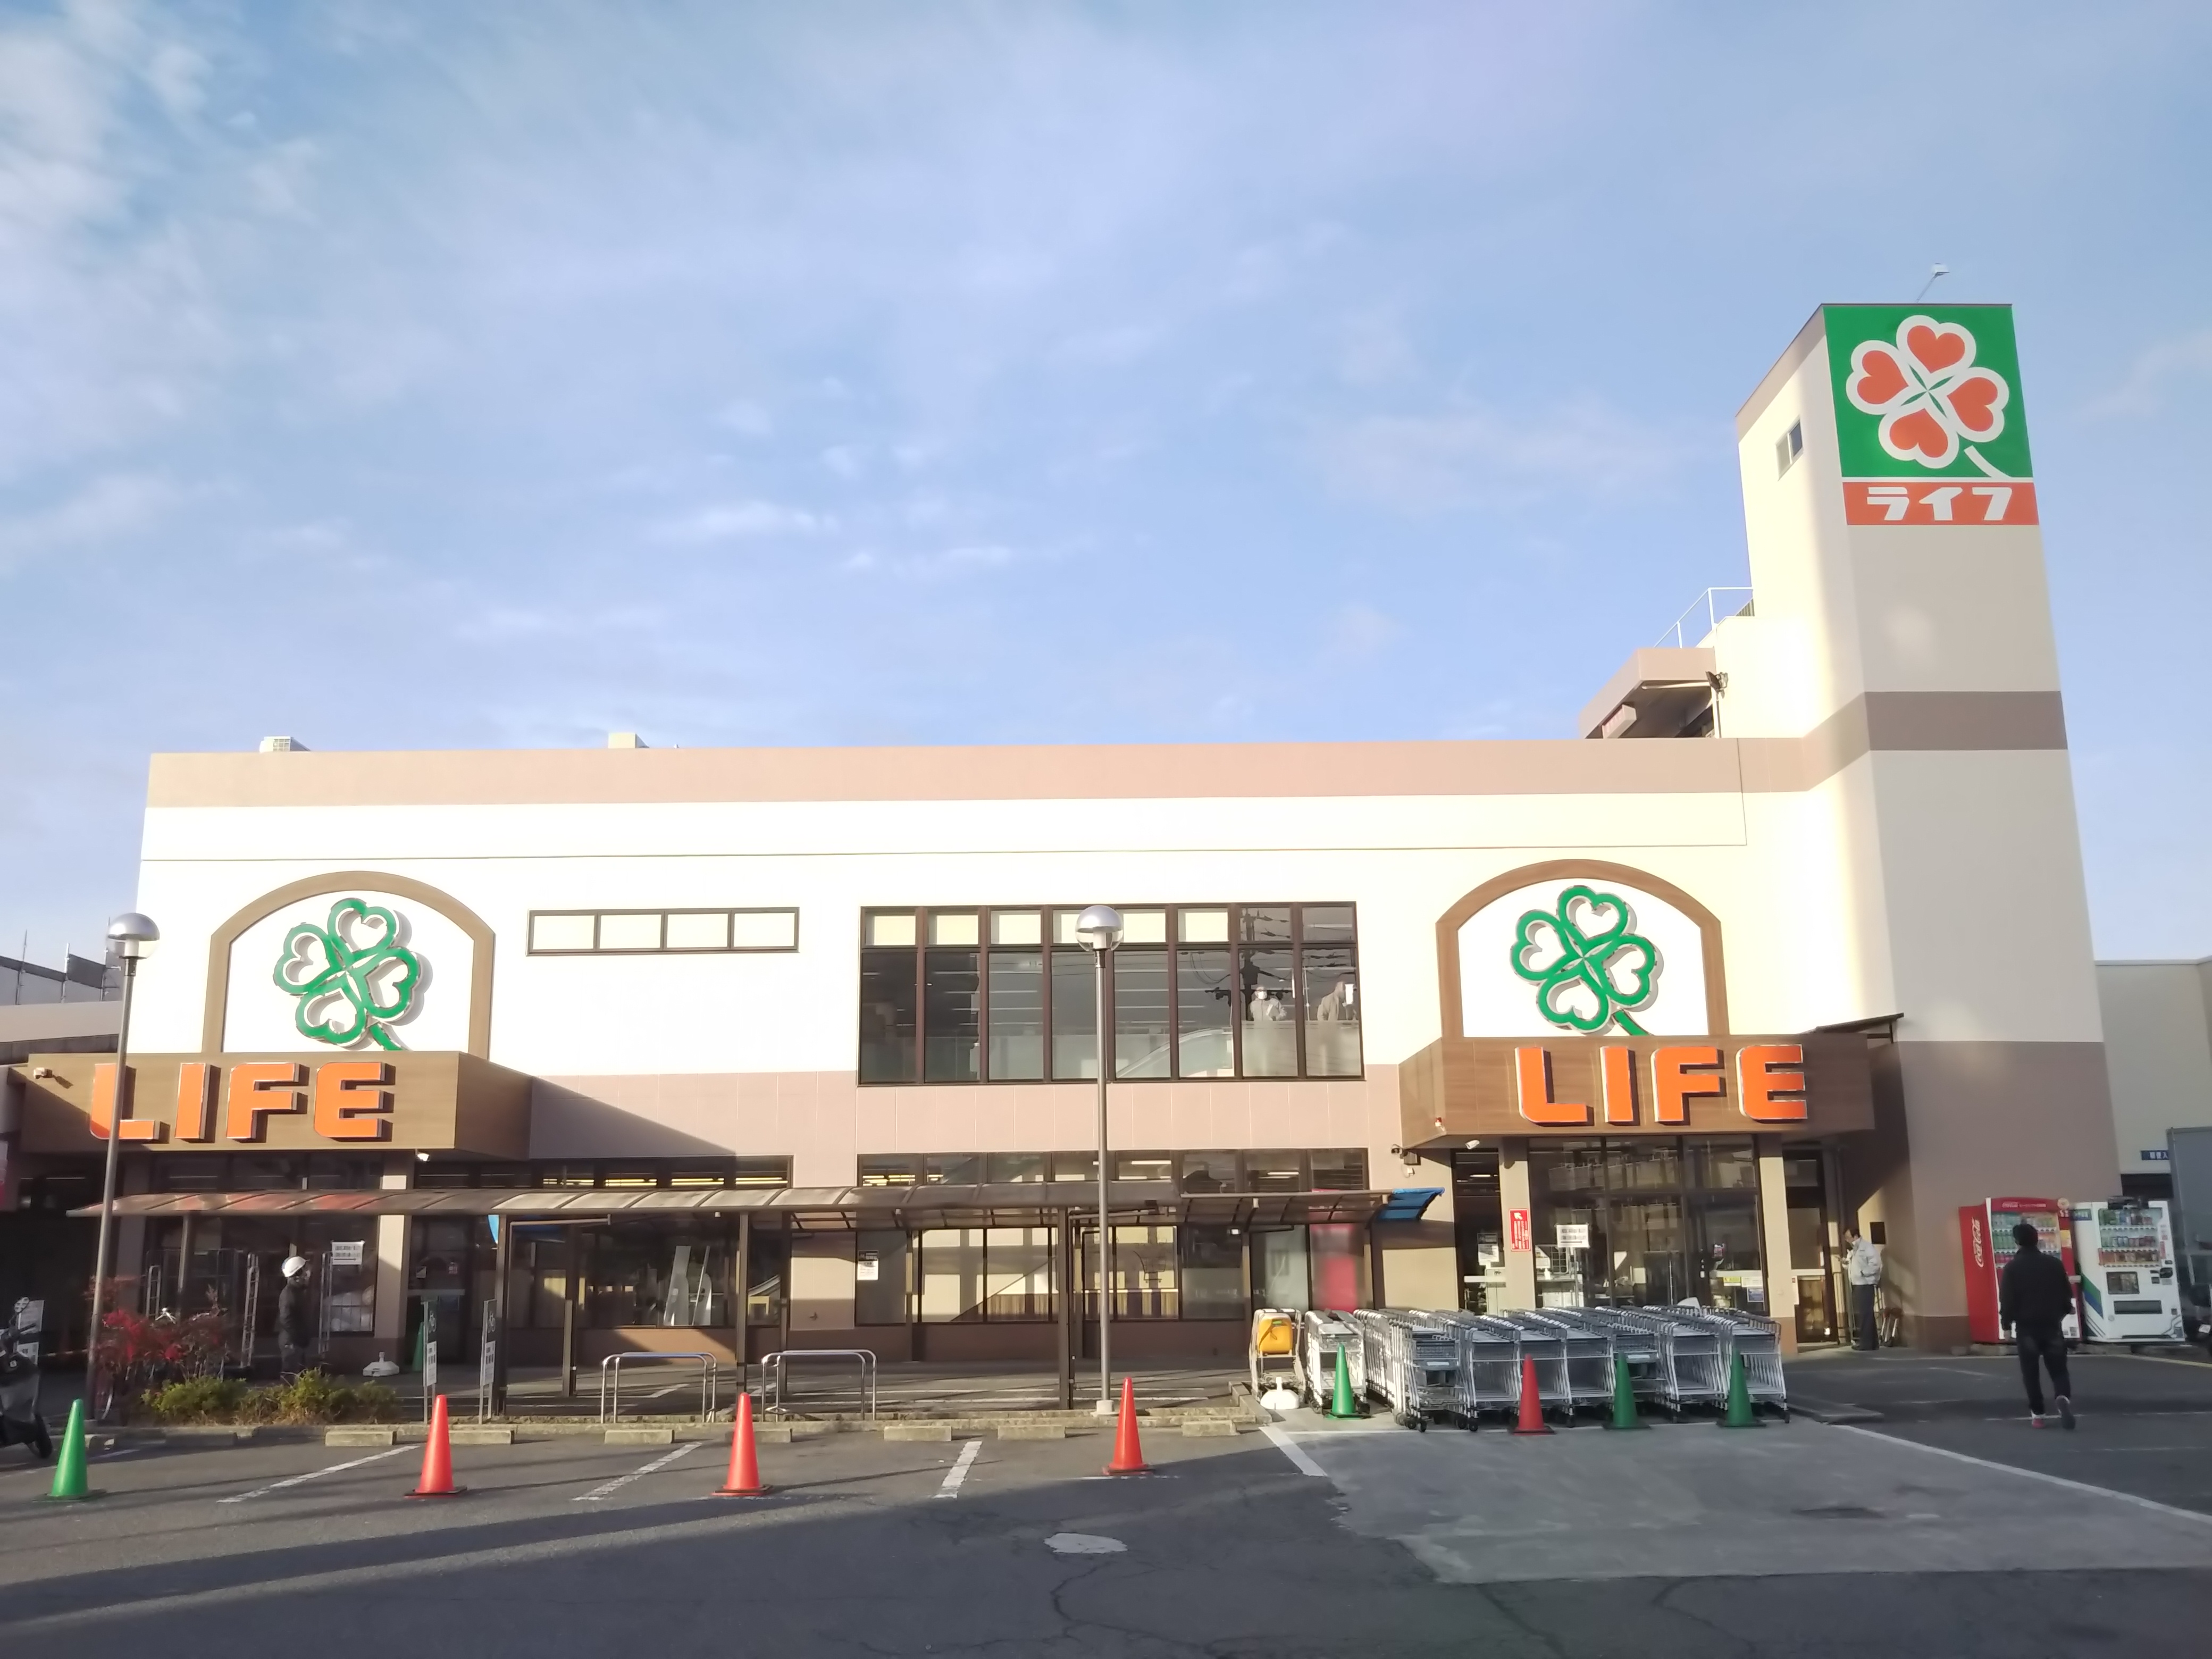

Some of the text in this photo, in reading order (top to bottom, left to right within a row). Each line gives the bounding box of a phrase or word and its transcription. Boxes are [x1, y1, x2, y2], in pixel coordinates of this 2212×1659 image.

[1866, 487, 2013, 521] ライフ
[89, 1061, 387, 1140] LIFE
[1514, 1044, 1808, 1124] LIFE
[1971, 1217, 1984, 1268] Coca-Cola
